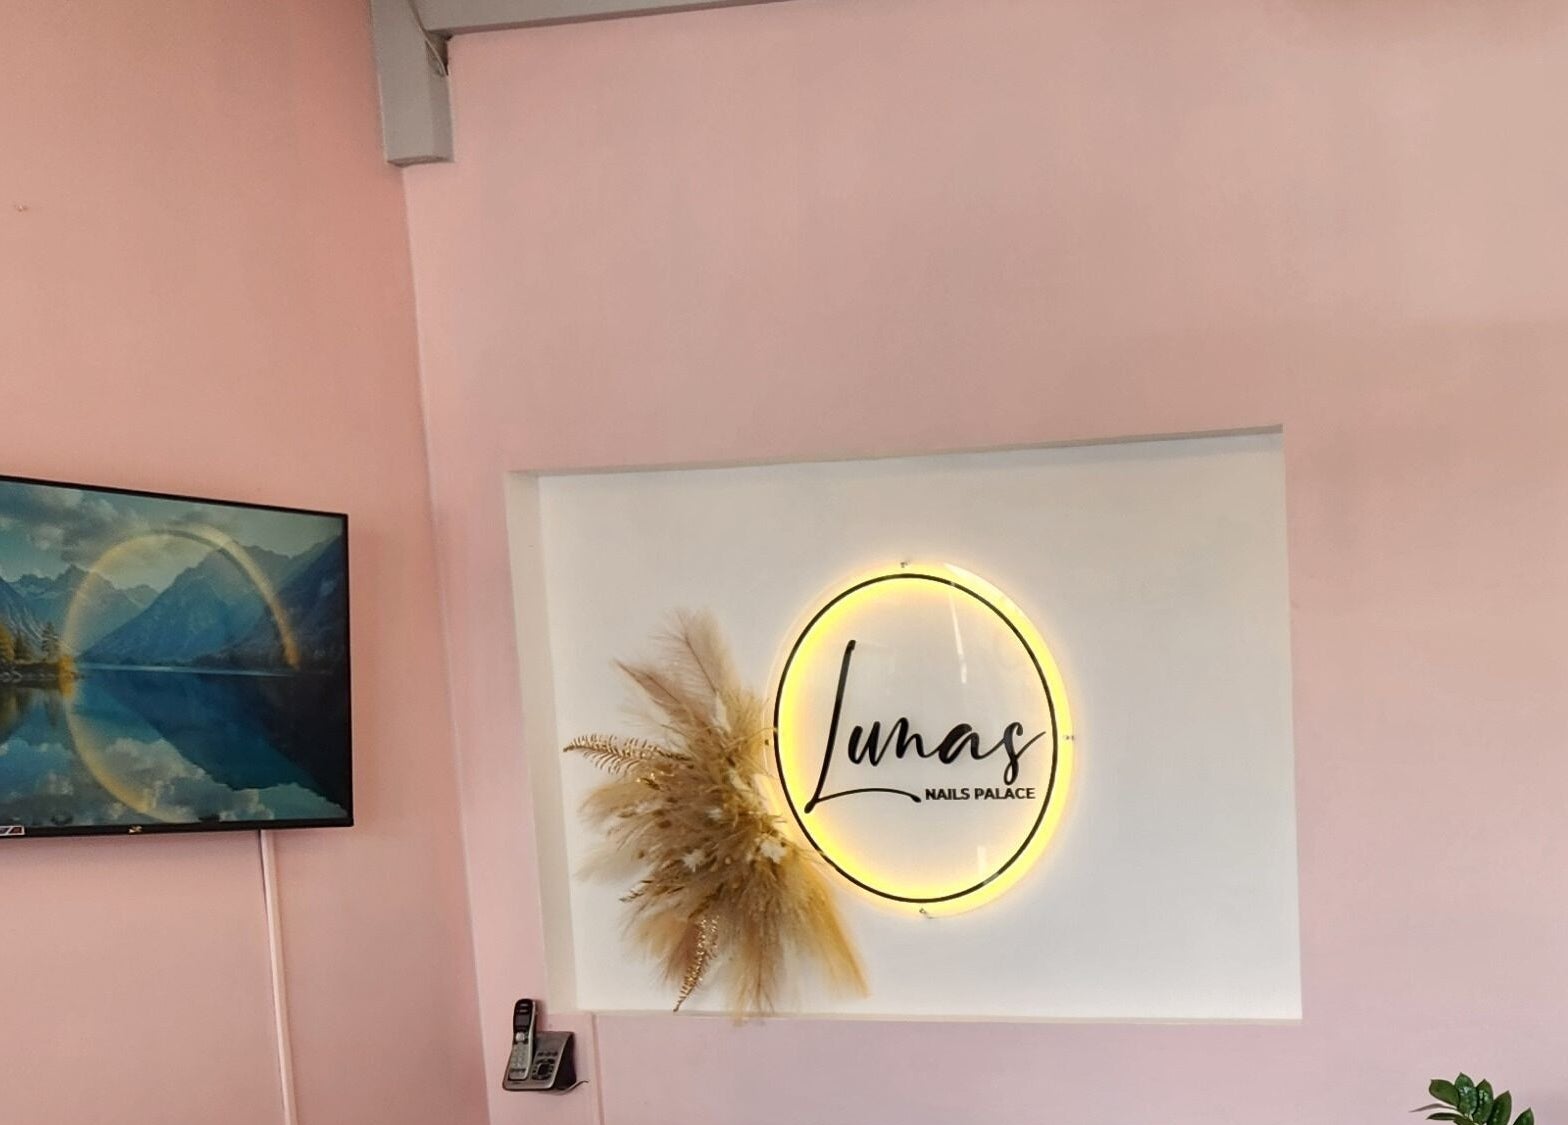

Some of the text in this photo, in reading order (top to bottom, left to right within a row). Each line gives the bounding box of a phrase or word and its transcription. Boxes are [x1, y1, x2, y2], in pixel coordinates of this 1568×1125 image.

[804, 639, 1046, 814] Lunas
[925, 787, 1036, 800] NAILS PALACE
